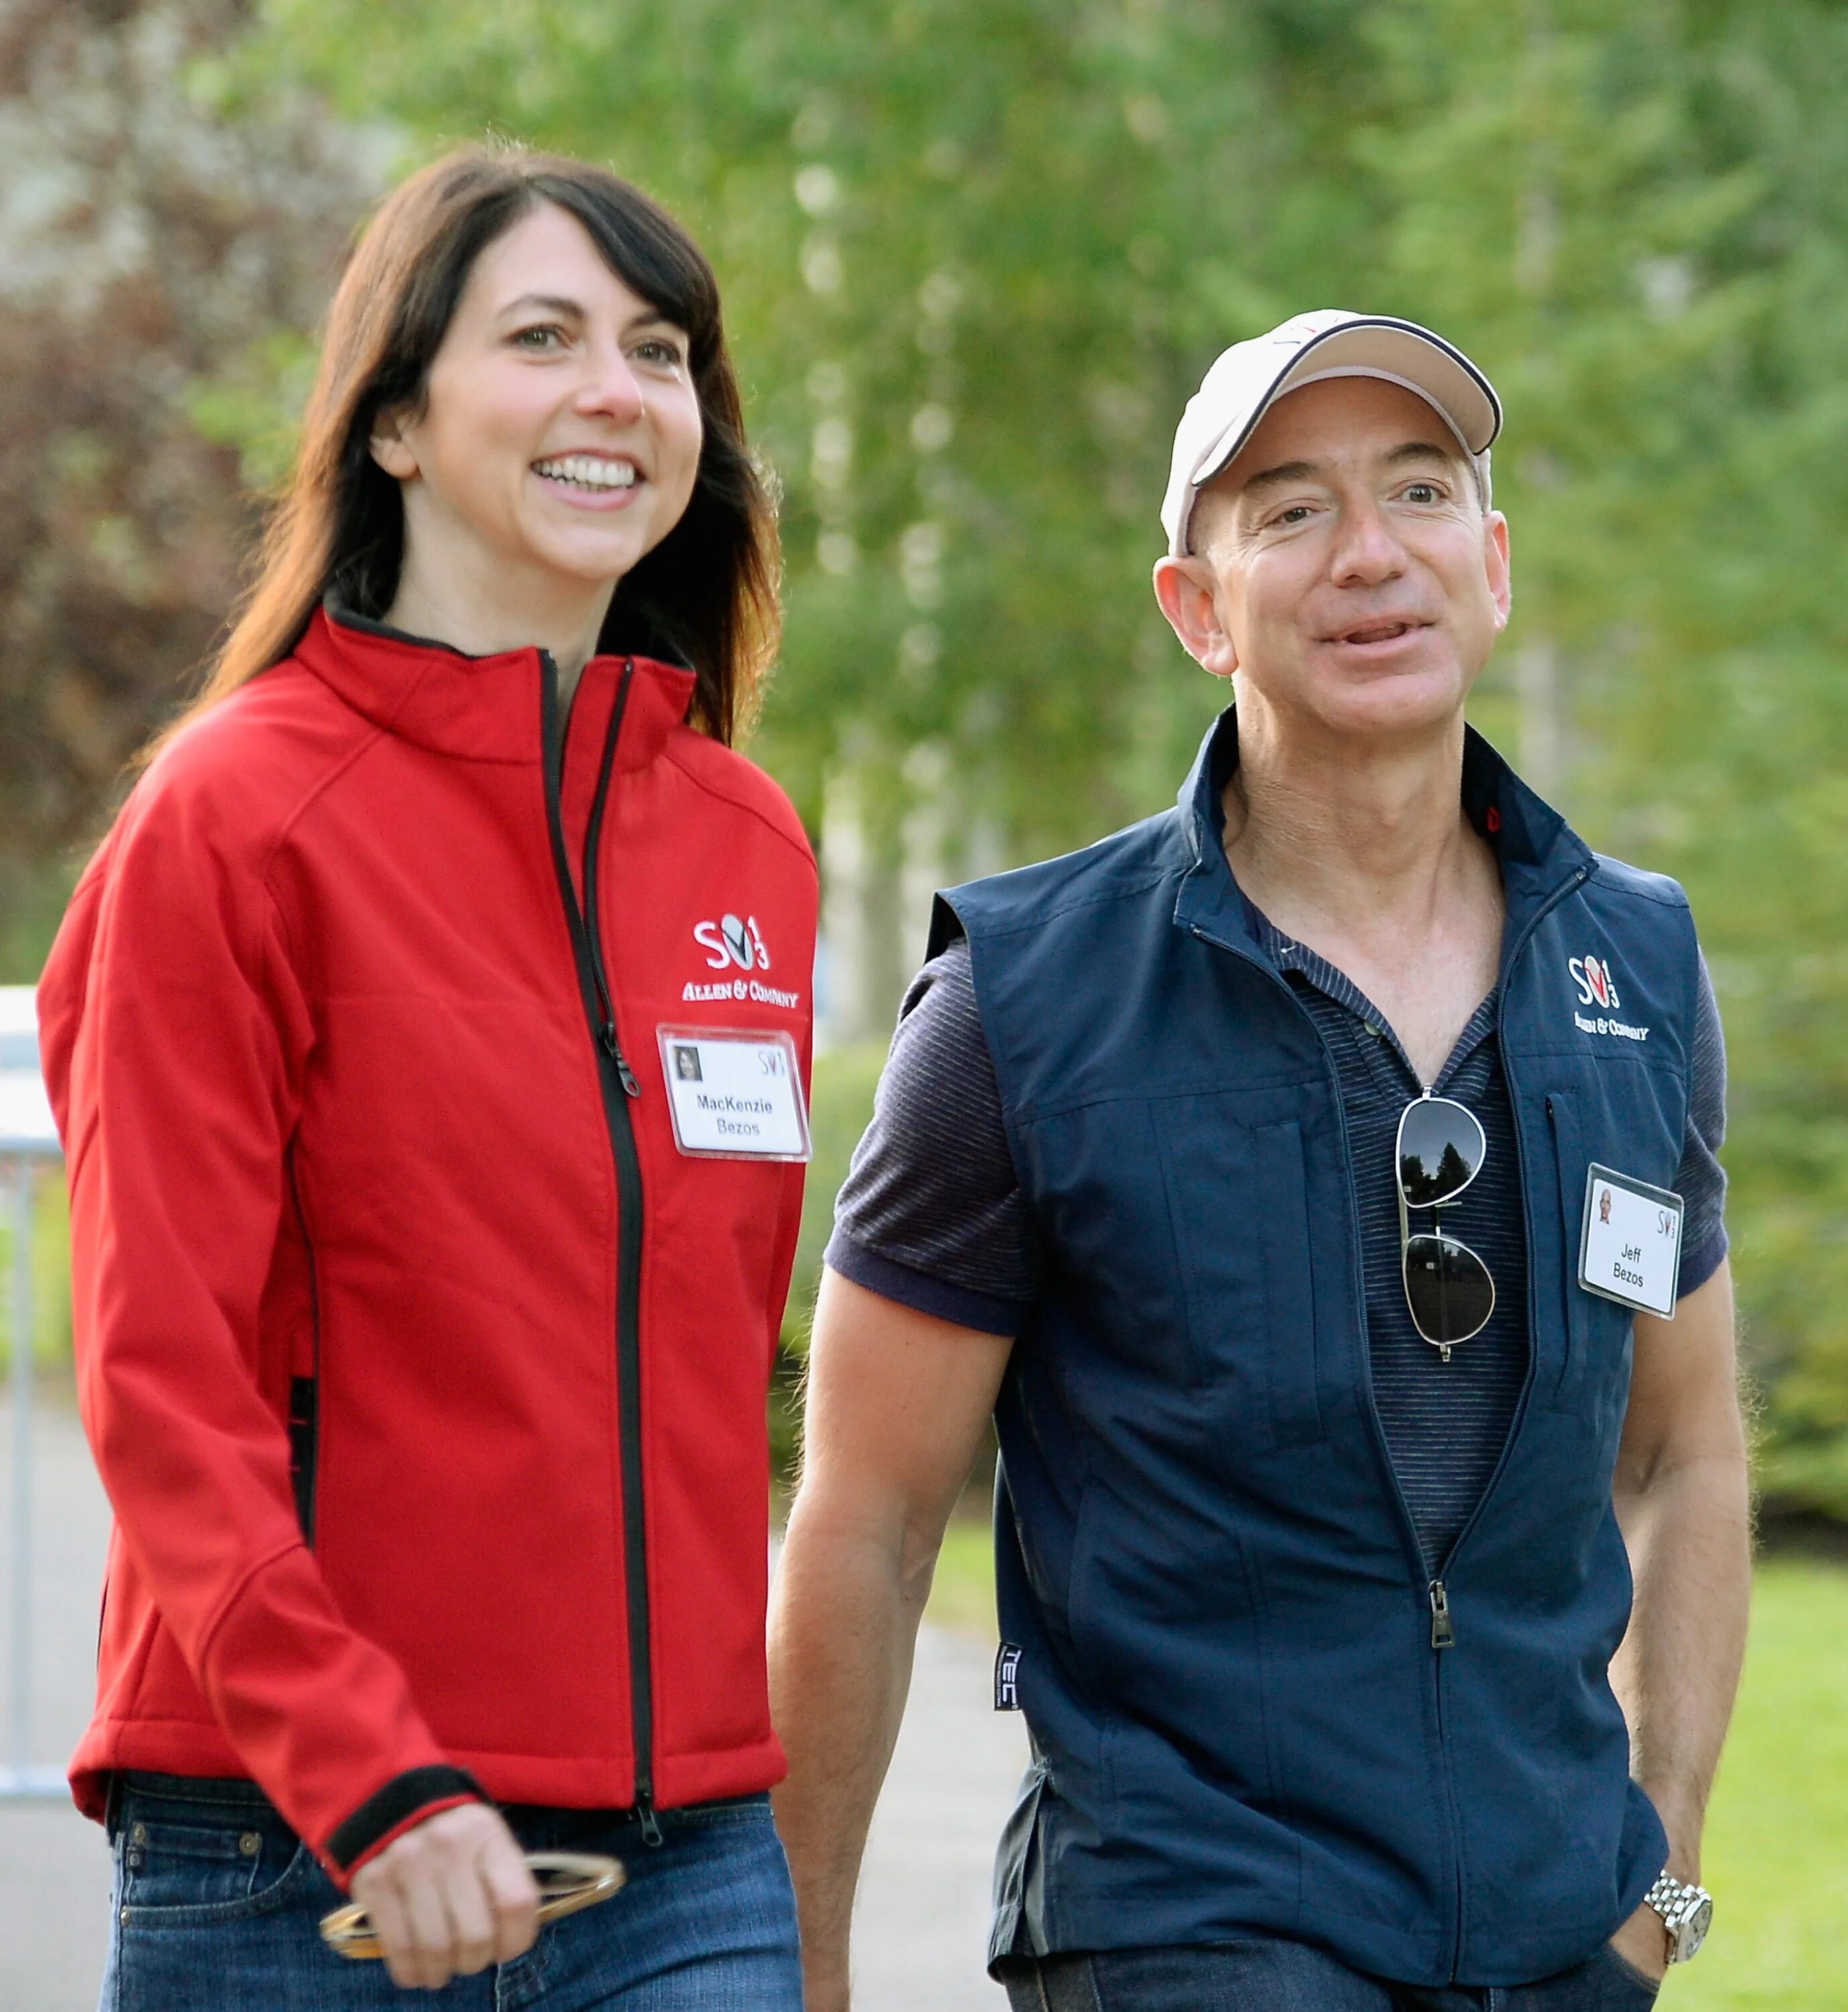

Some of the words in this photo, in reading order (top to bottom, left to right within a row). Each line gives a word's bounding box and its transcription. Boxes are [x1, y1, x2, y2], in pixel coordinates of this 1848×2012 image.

[683, 982, 732, 1001] ALLEN
[734, 979, 748, 1000] &
[749, 979, 799, 1009] COMPANY
[1597, 1017, 1609, 1035] &
[697, 1095, 773, 1114] MacKenzie
[717, 1119, 760, 1136] Bezos
[1621, 1243, 1641, 1262] Jeff
[1613, 1262, 1643, 1288] Bezos
